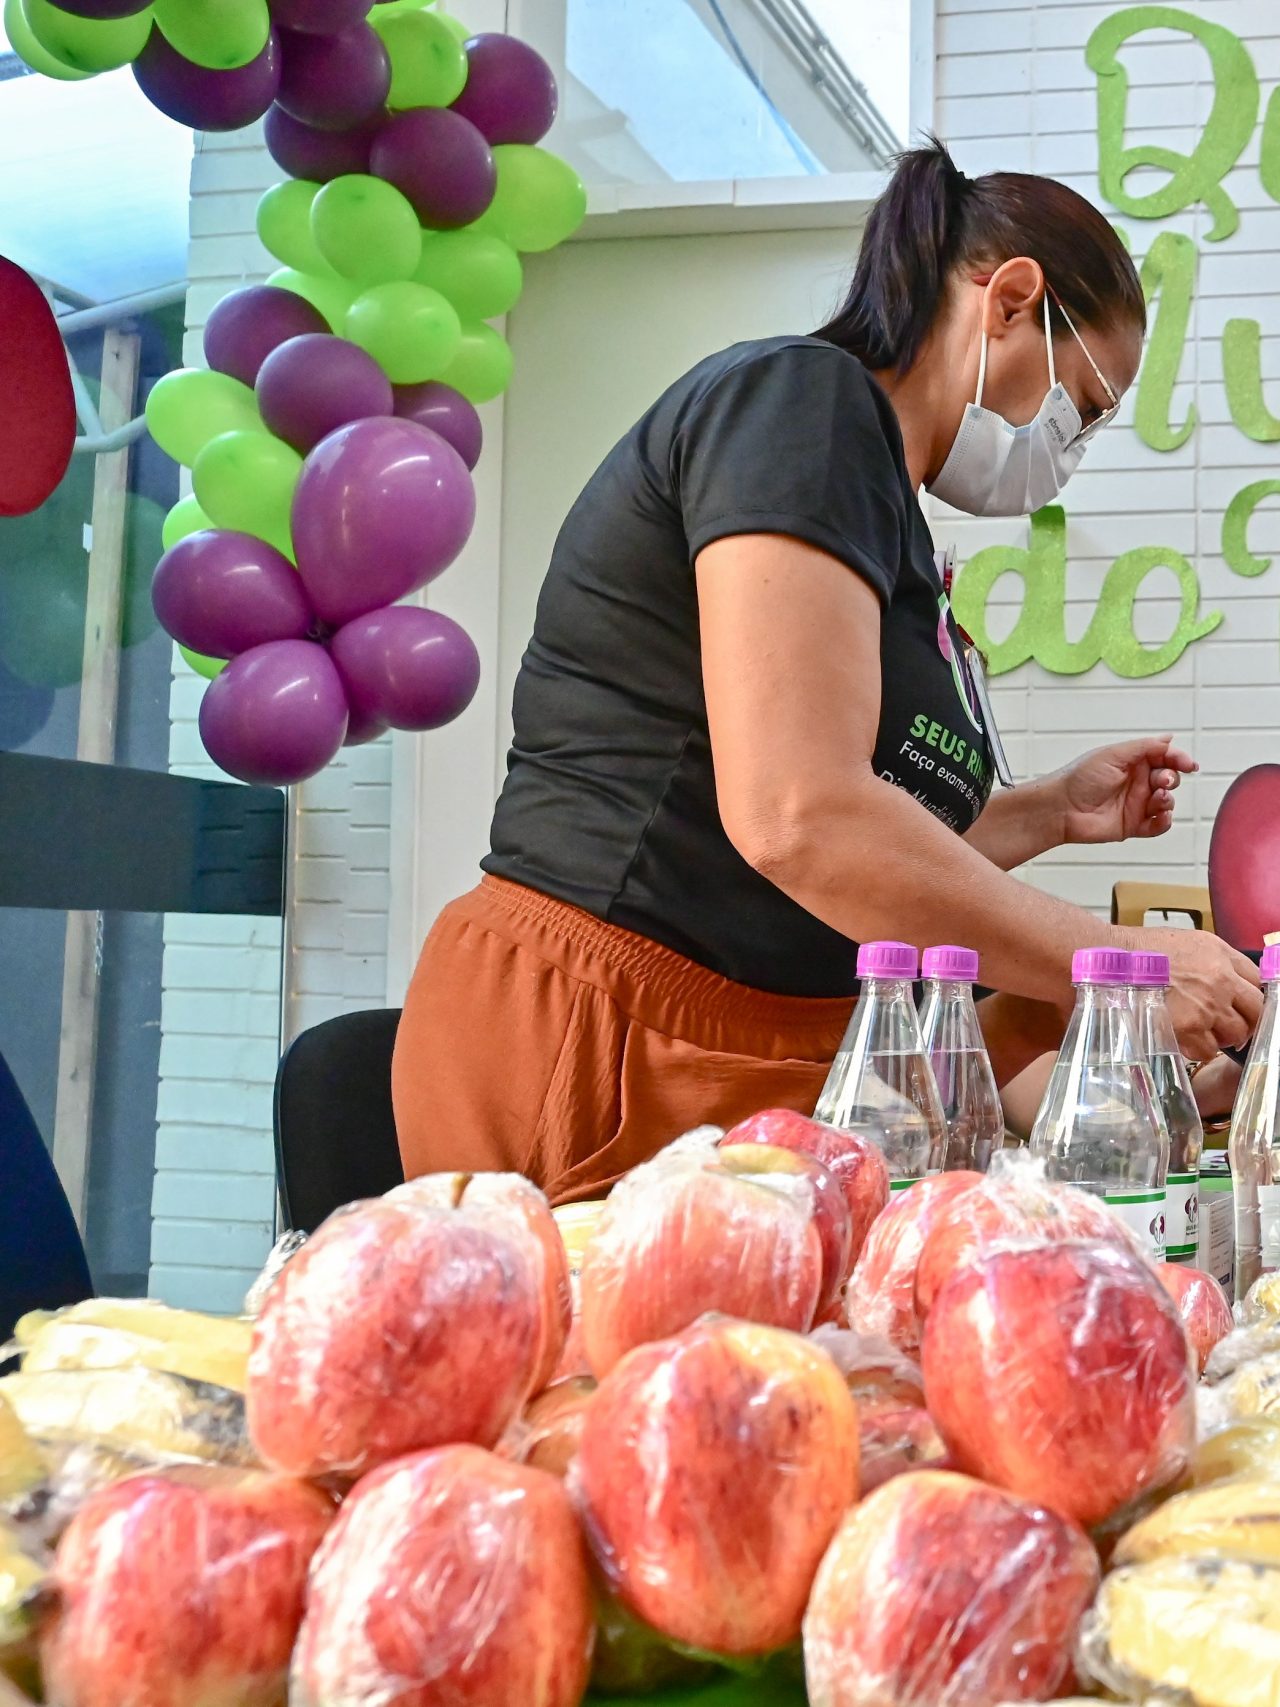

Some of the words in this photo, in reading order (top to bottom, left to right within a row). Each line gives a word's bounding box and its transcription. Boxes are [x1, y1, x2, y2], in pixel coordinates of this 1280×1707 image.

[950, 505, 1225, 678] do
[909, 714, 967, 763] SEUS
[899, 741, 935, 772] Faça
[937, 766, 968, 793] exame
